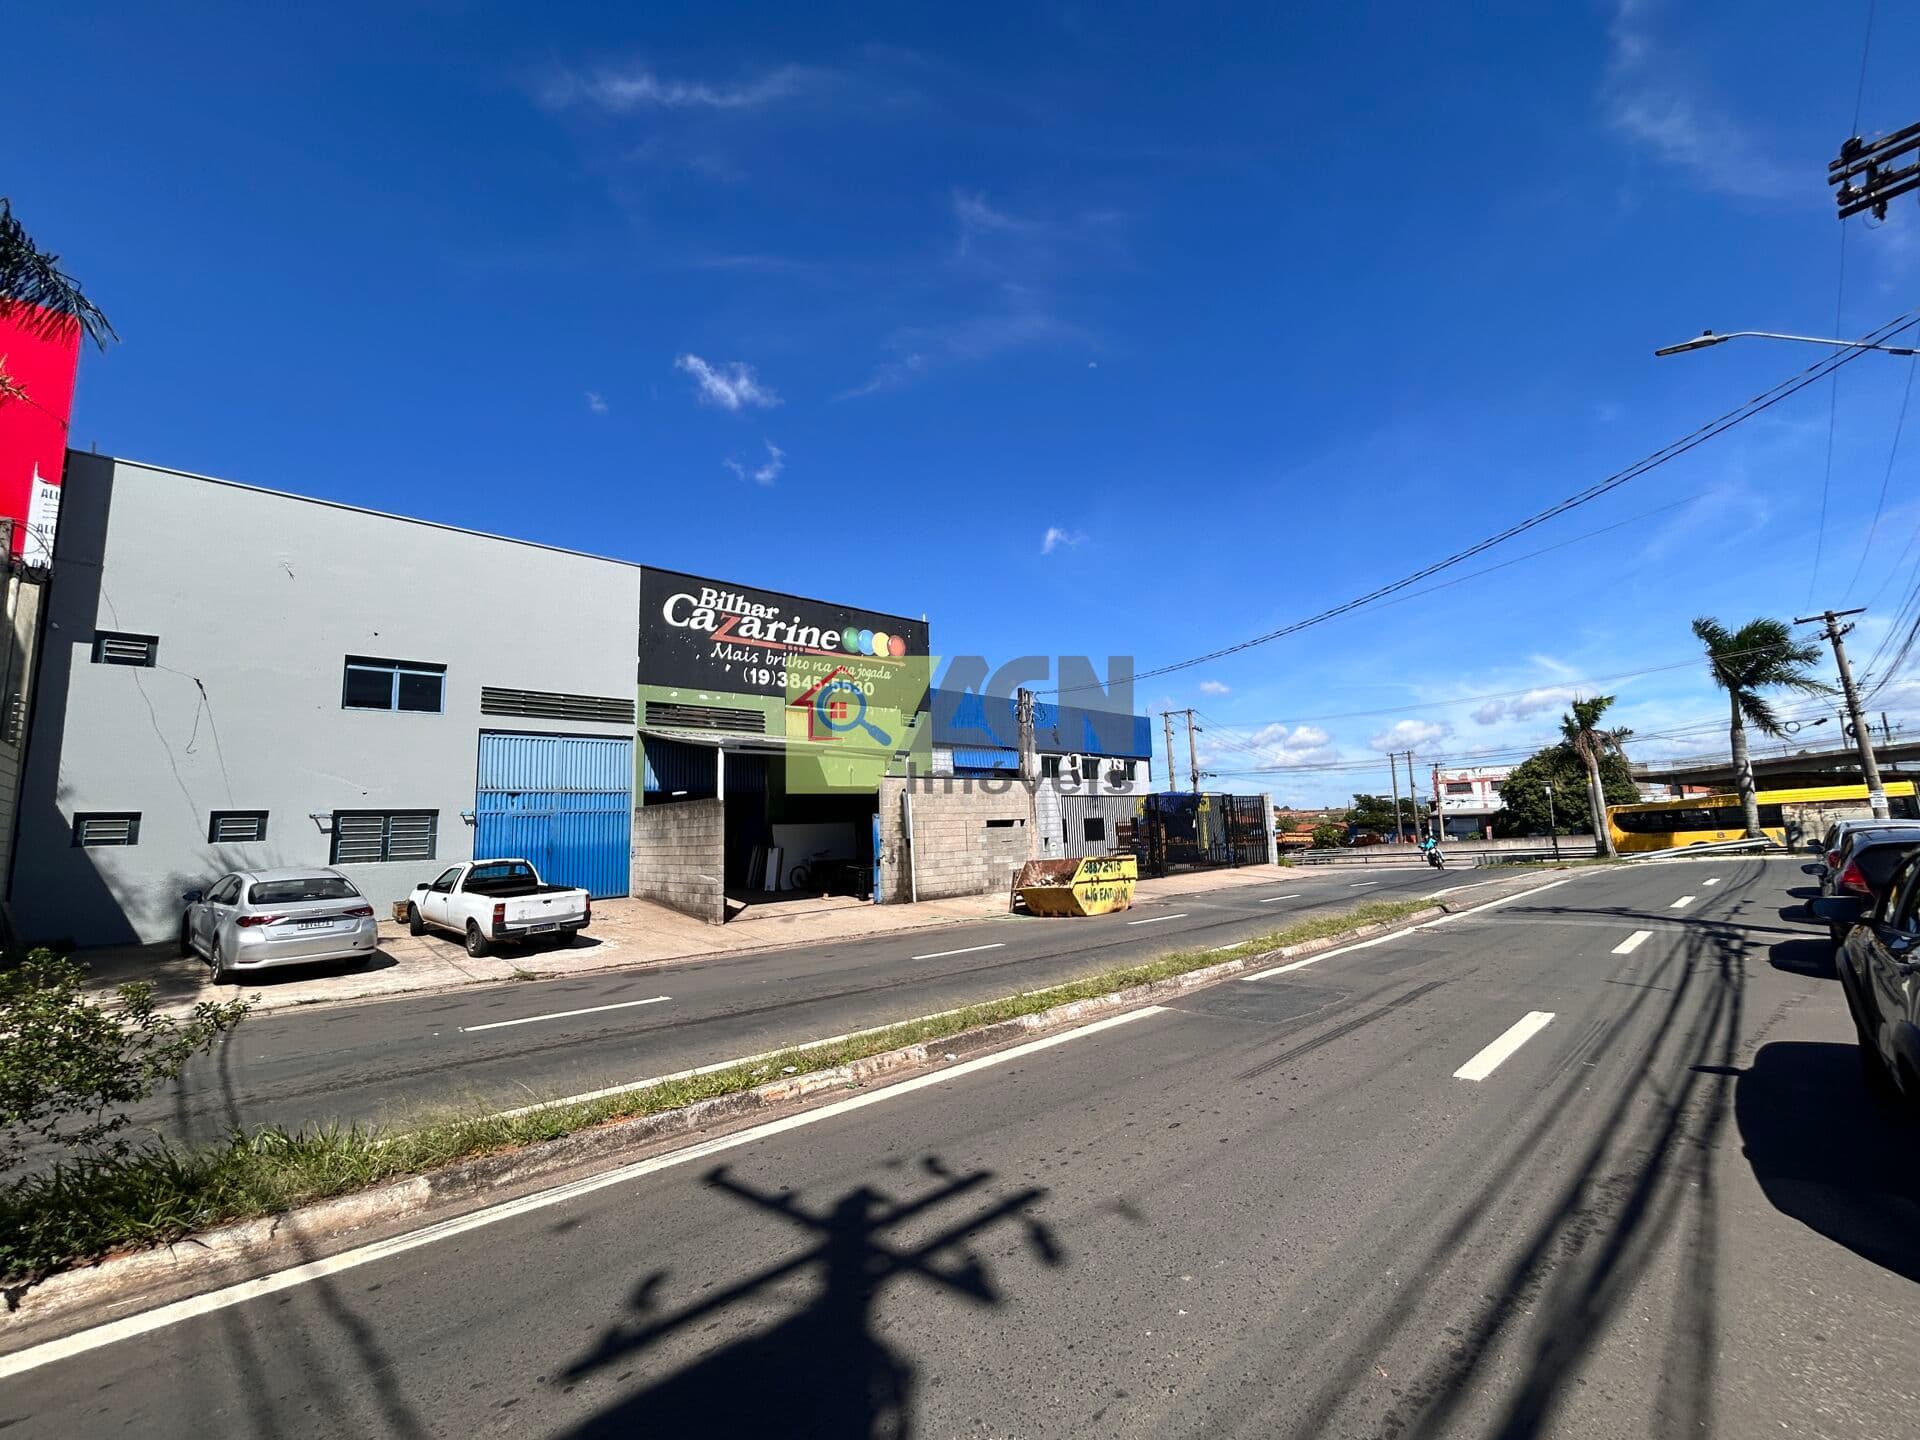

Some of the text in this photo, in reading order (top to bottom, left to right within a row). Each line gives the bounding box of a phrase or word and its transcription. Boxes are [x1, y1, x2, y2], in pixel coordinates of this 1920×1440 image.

[662, 593, 841, 650] Cazarine
[698, 587, 779, 619] Bilhar
[711, 643, 759, 664] Mais
[766, 649, 810, 671] brilho
[813, 660, 832, 673] na
[854, 664, 892, 682] jogada
